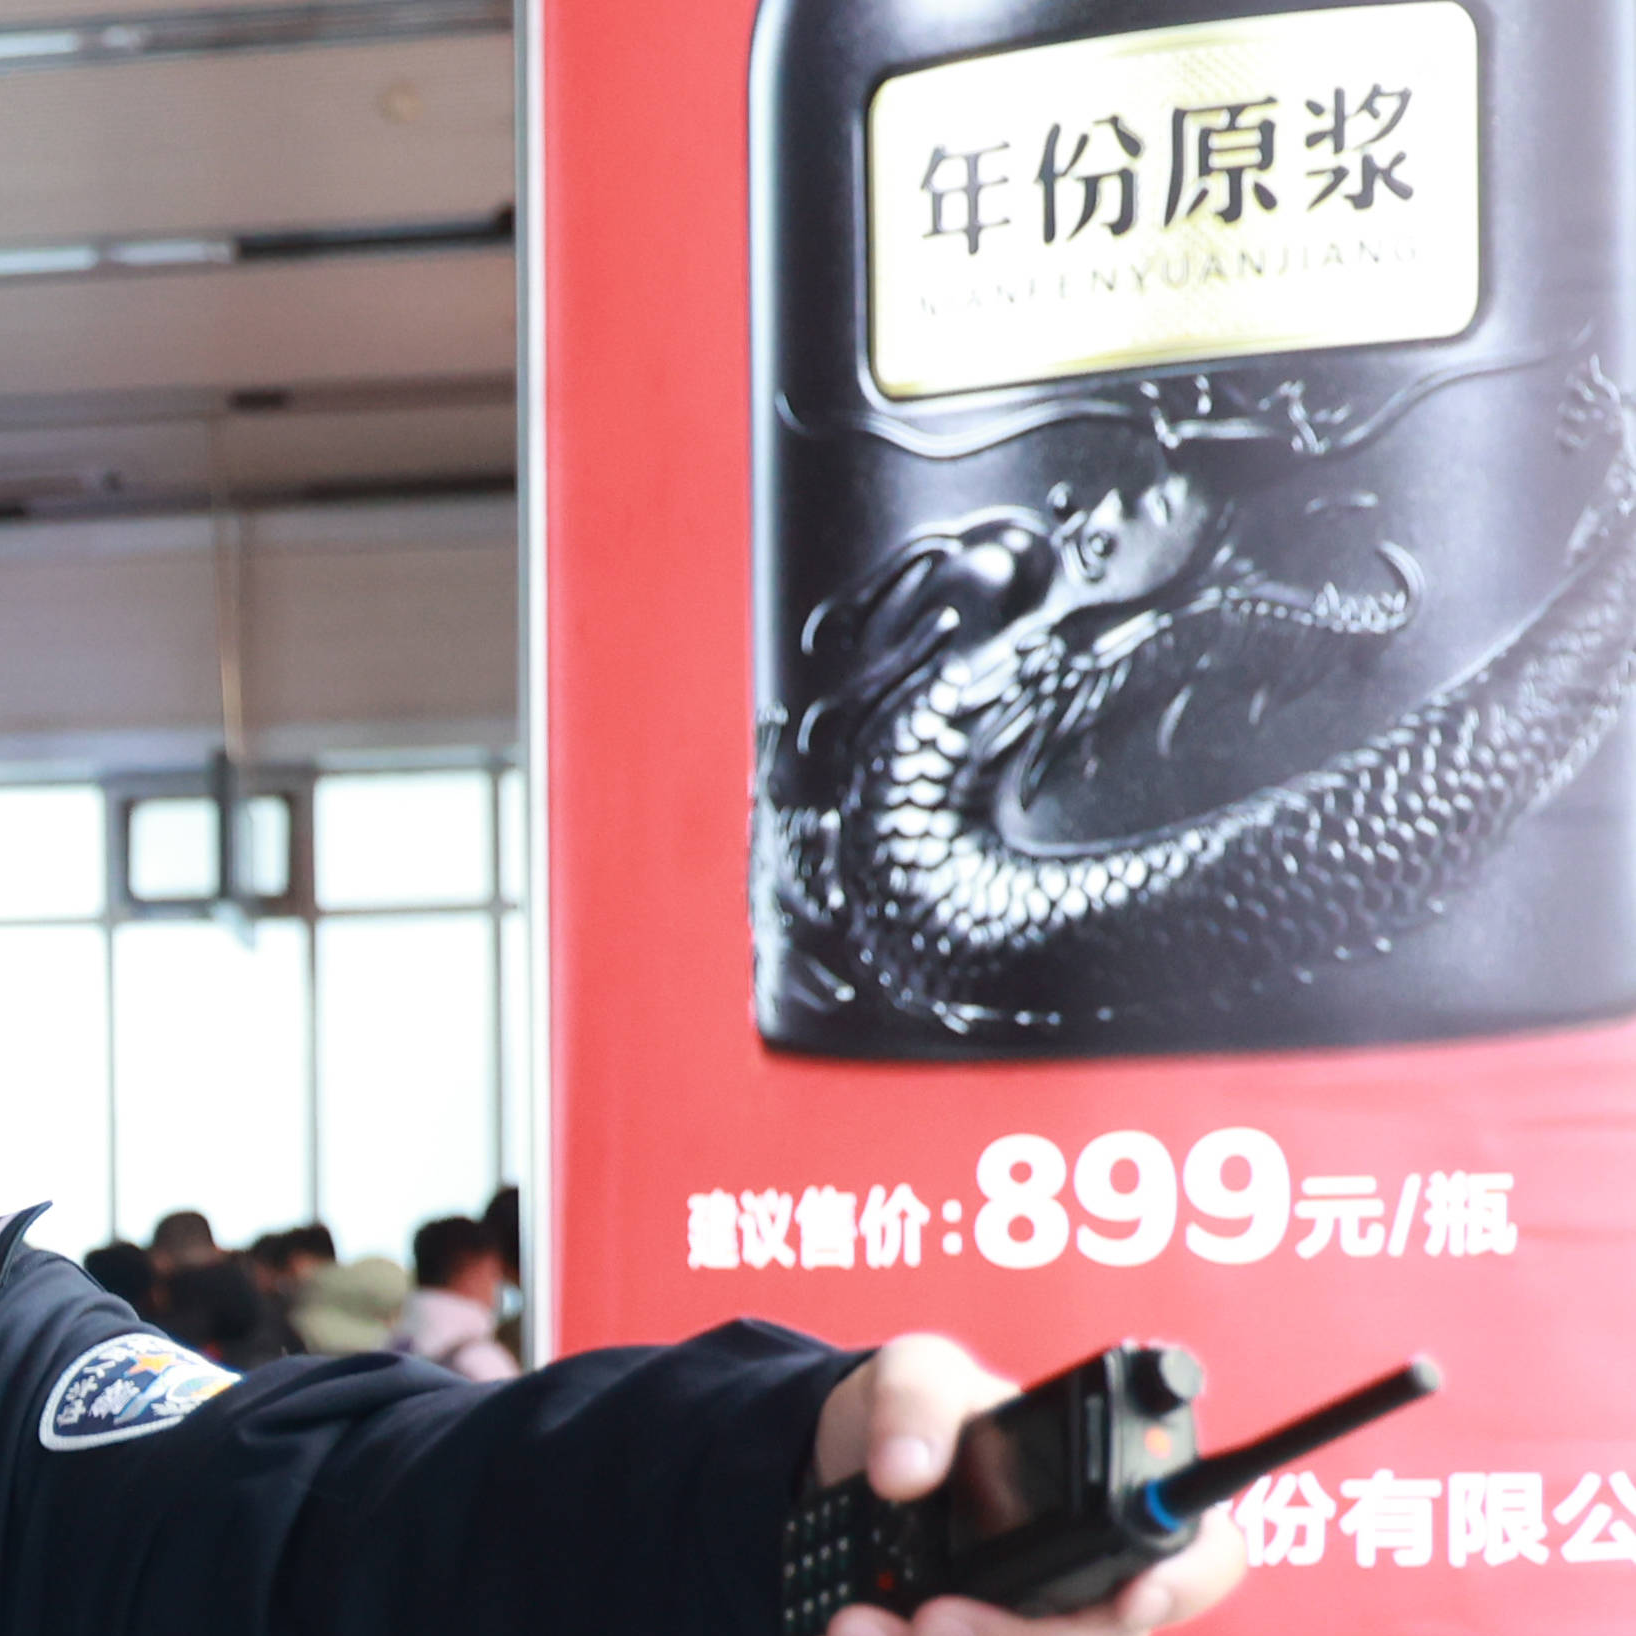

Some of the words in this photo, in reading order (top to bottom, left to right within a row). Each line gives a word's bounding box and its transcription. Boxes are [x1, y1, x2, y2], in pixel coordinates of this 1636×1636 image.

[921, 83, 1414, 256] 年份原浆
[920, 232, 1417, 315] NANENYUANJIANG
[1217, 1468, 1636, 1568] 份有限公
